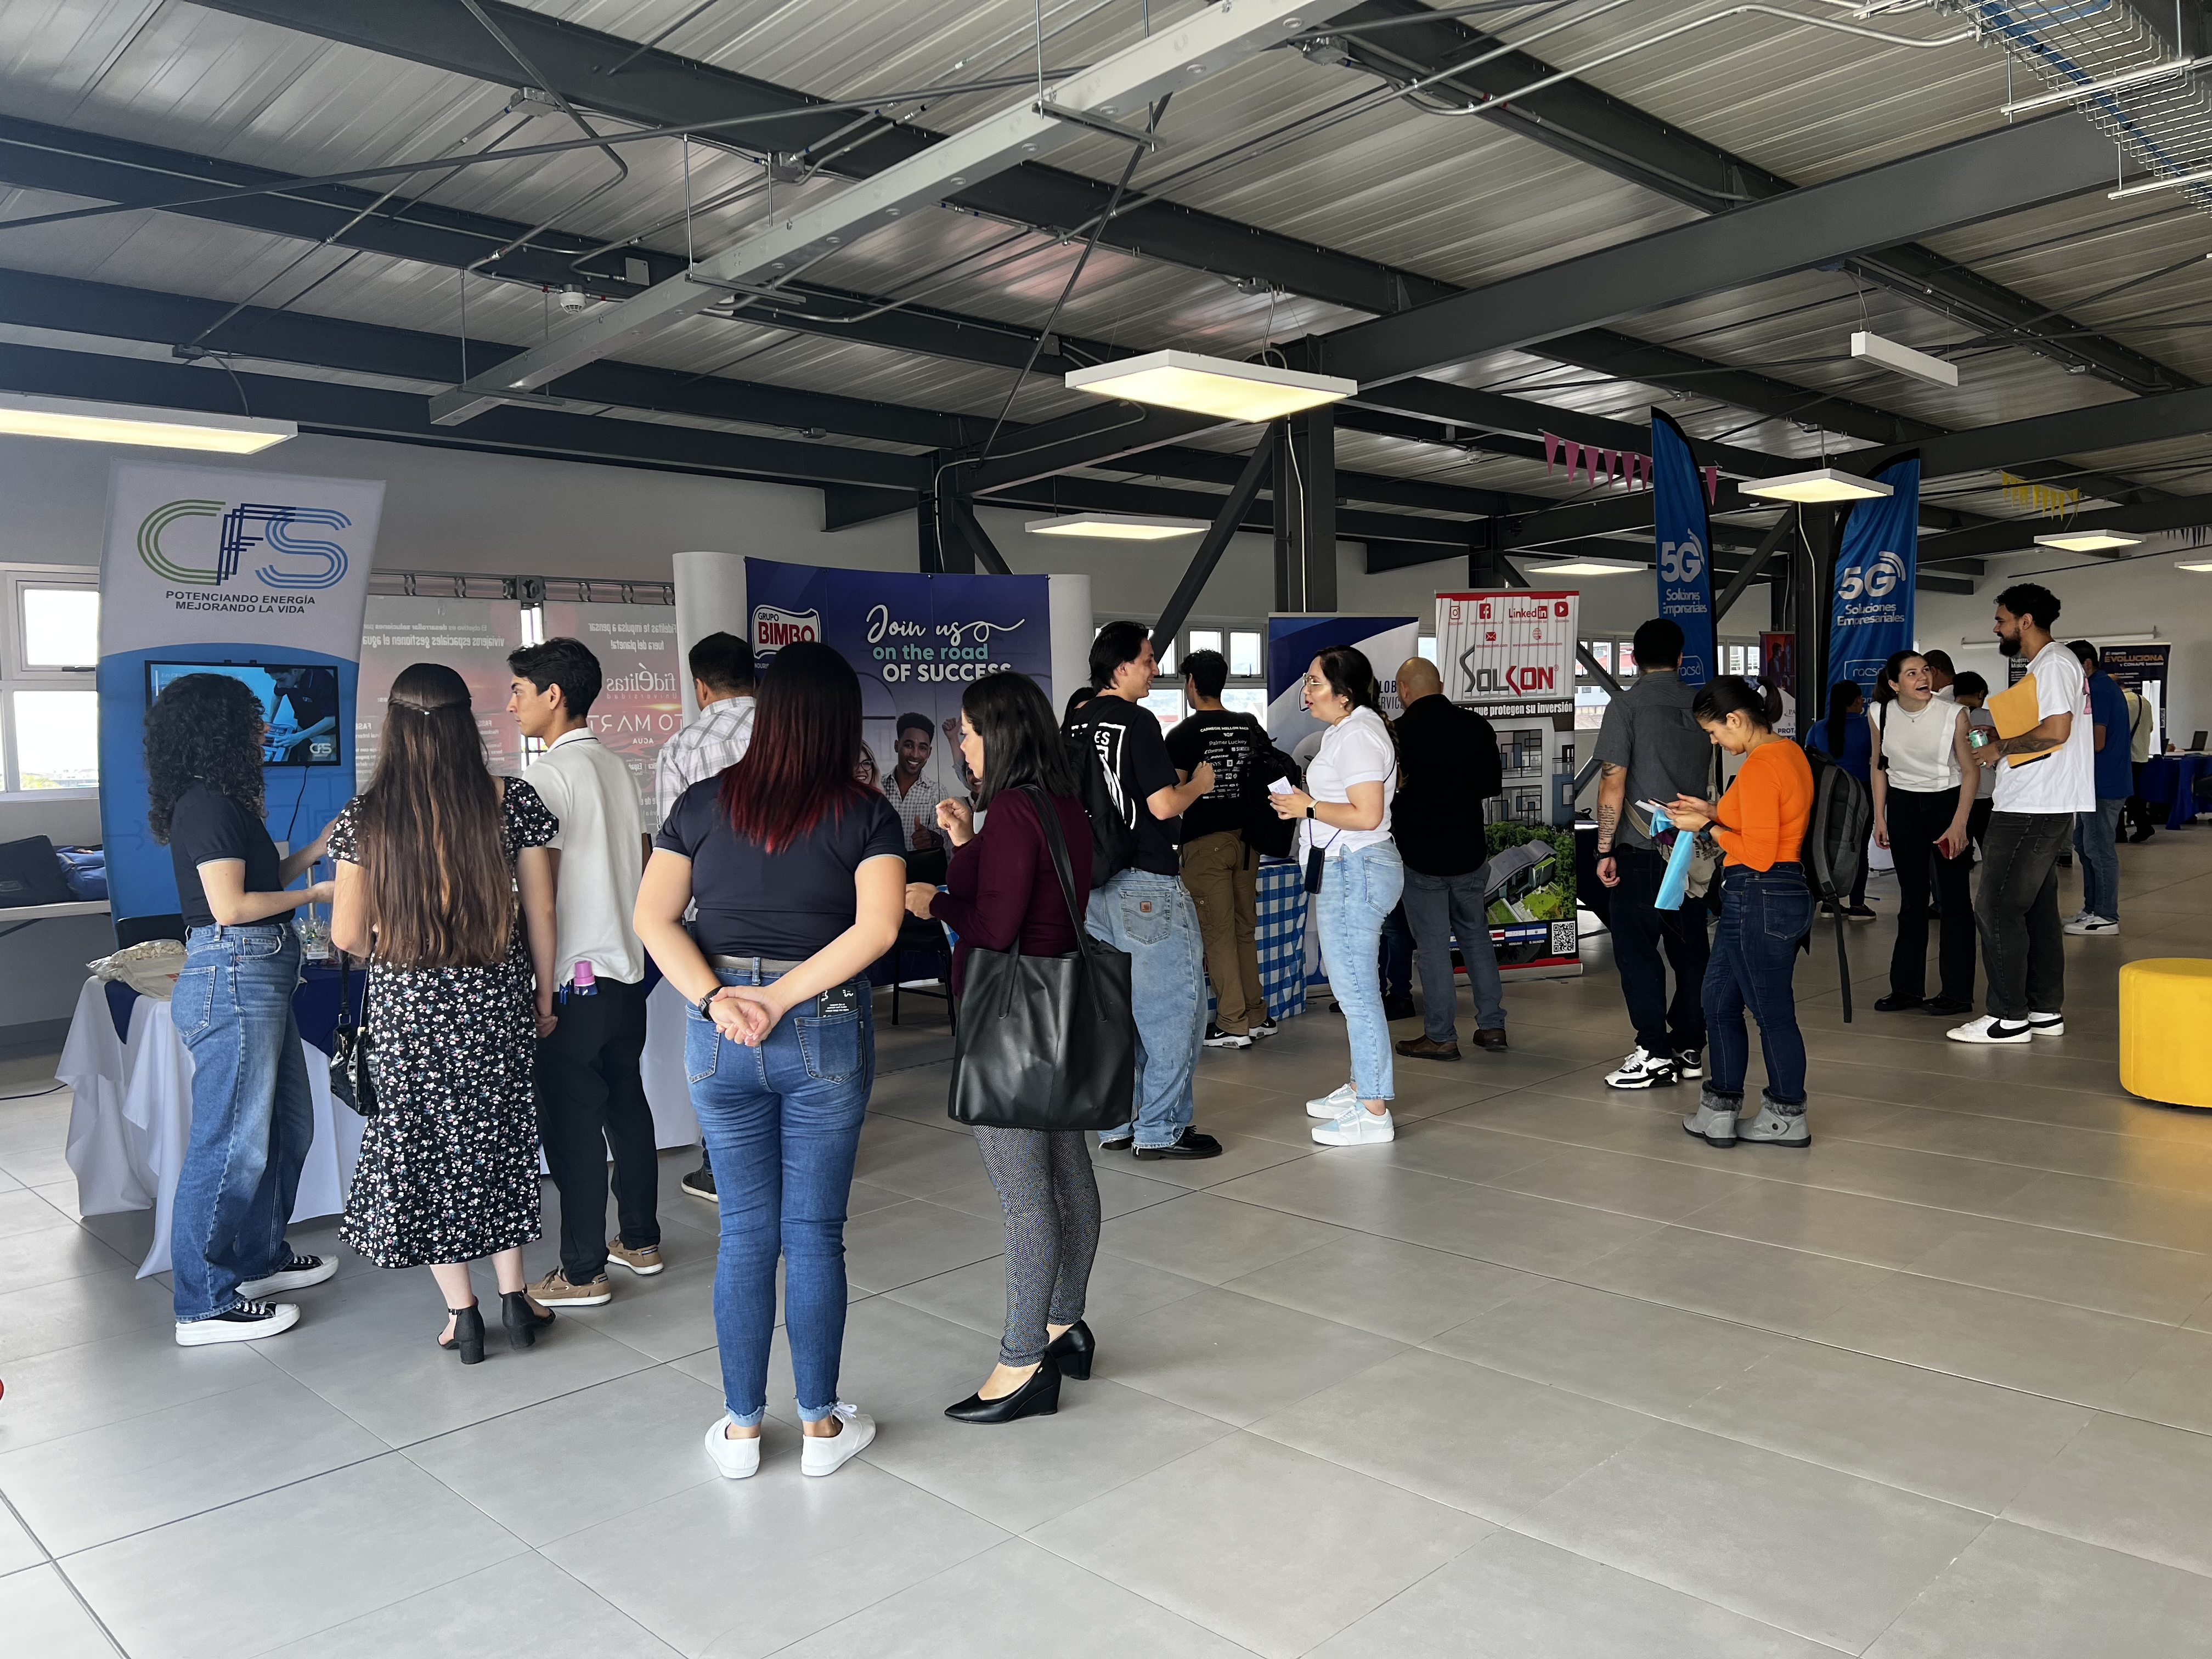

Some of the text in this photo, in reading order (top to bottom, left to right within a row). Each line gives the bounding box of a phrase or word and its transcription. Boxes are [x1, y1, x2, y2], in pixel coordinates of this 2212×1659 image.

[137, 499, 352, 589] CFS
[1661, 541, 1701, 583] 5G
[1838, 563, 1897, 600] 5G
[166, 590, 315, 605] POTENCIANDO ENERGÍA
[176, 601, 304, 614] MEJORANDO LA VIDA
[1509, 605, 1548, 619] Linkedin
[1845, 602, 1897, 615] Soluciones
[758, 612, 780, 622] GRUPO
[866, 604, 926, 644] Join
[1837, 612, 1905, 627] Empresariales
[758, 621, 815, 645] BIMBO
[873, 643, 989, 661] on the road
[2104, 654, 2164, 663] EVOLUCIONA
[883, 663, 911, 682] OF
[1459, 644, 1554, 697] SOLCON
[1378, 696, 1403, 709] RVIC
[1489, 704, 1525, 716] protegen
[1526, 704, 1536, 714] su
[1537, 701, 1573, 713] inversión
[309, 743, 332, 754] CFS
